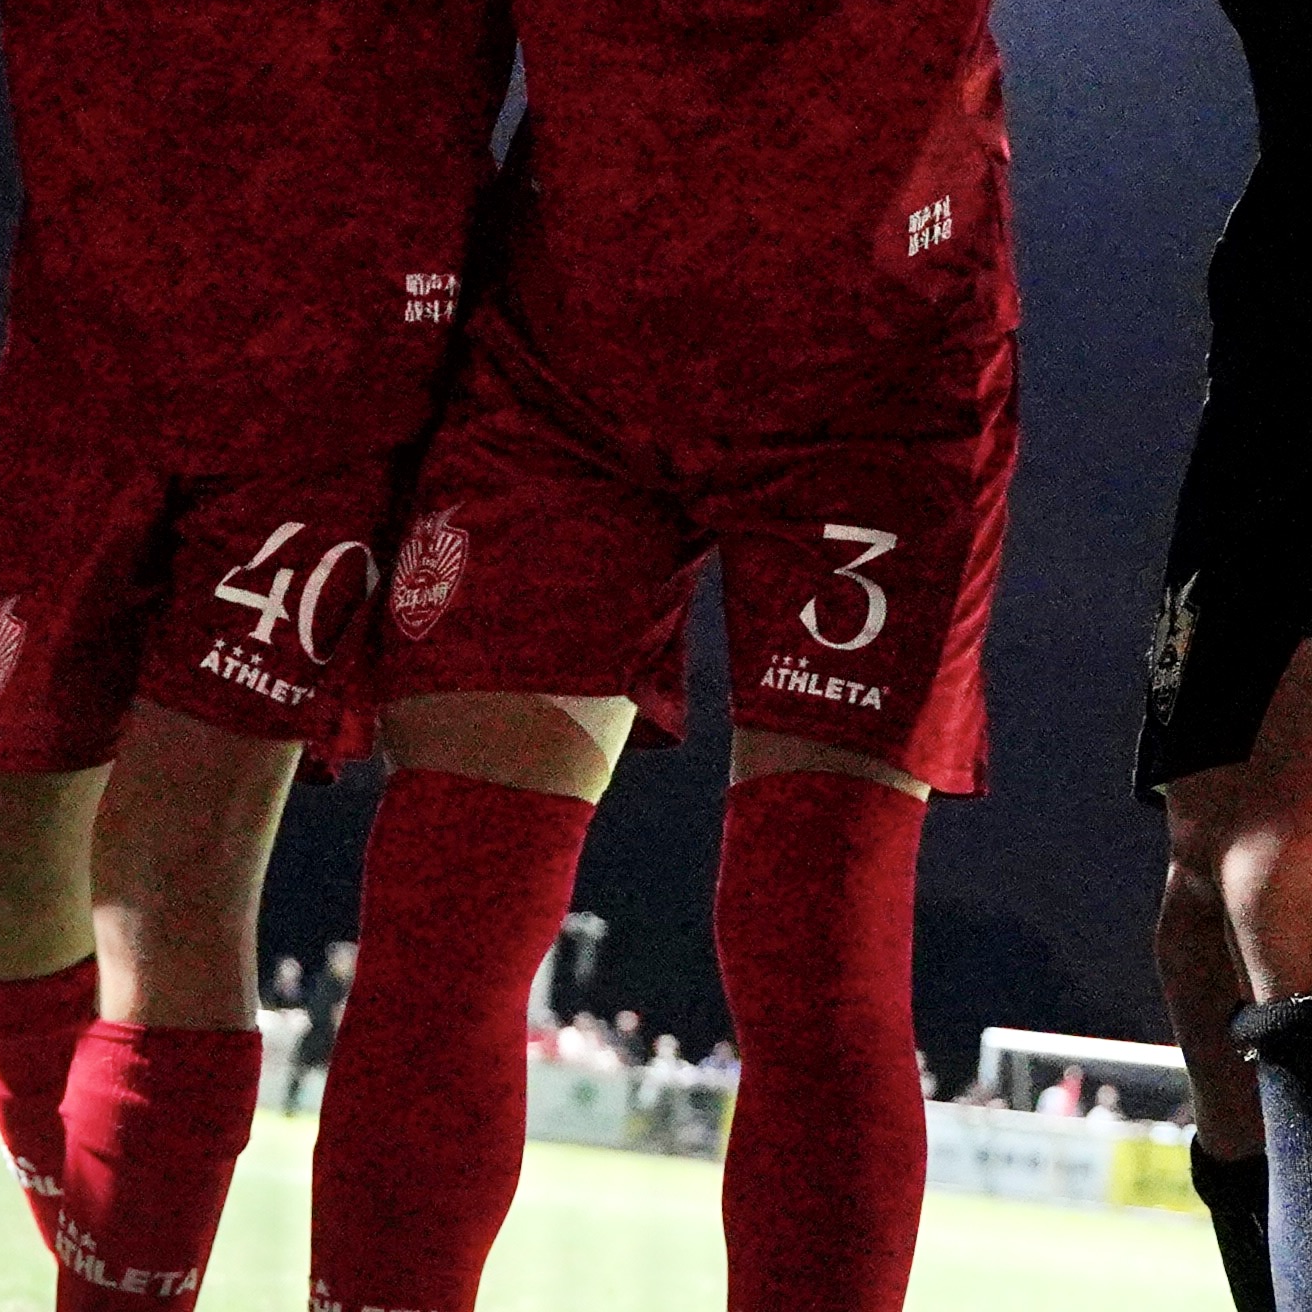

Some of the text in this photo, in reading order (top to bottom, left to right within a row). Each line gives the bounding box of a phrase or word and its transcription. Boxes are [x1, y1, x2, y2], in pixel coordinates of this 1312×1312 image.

[214, 521, 380, 665] 40
[799, 524, 898, 651] 3
[199, 650, 316, 706] ATHLET
[760, 666, 881, 711] ATHLETA
